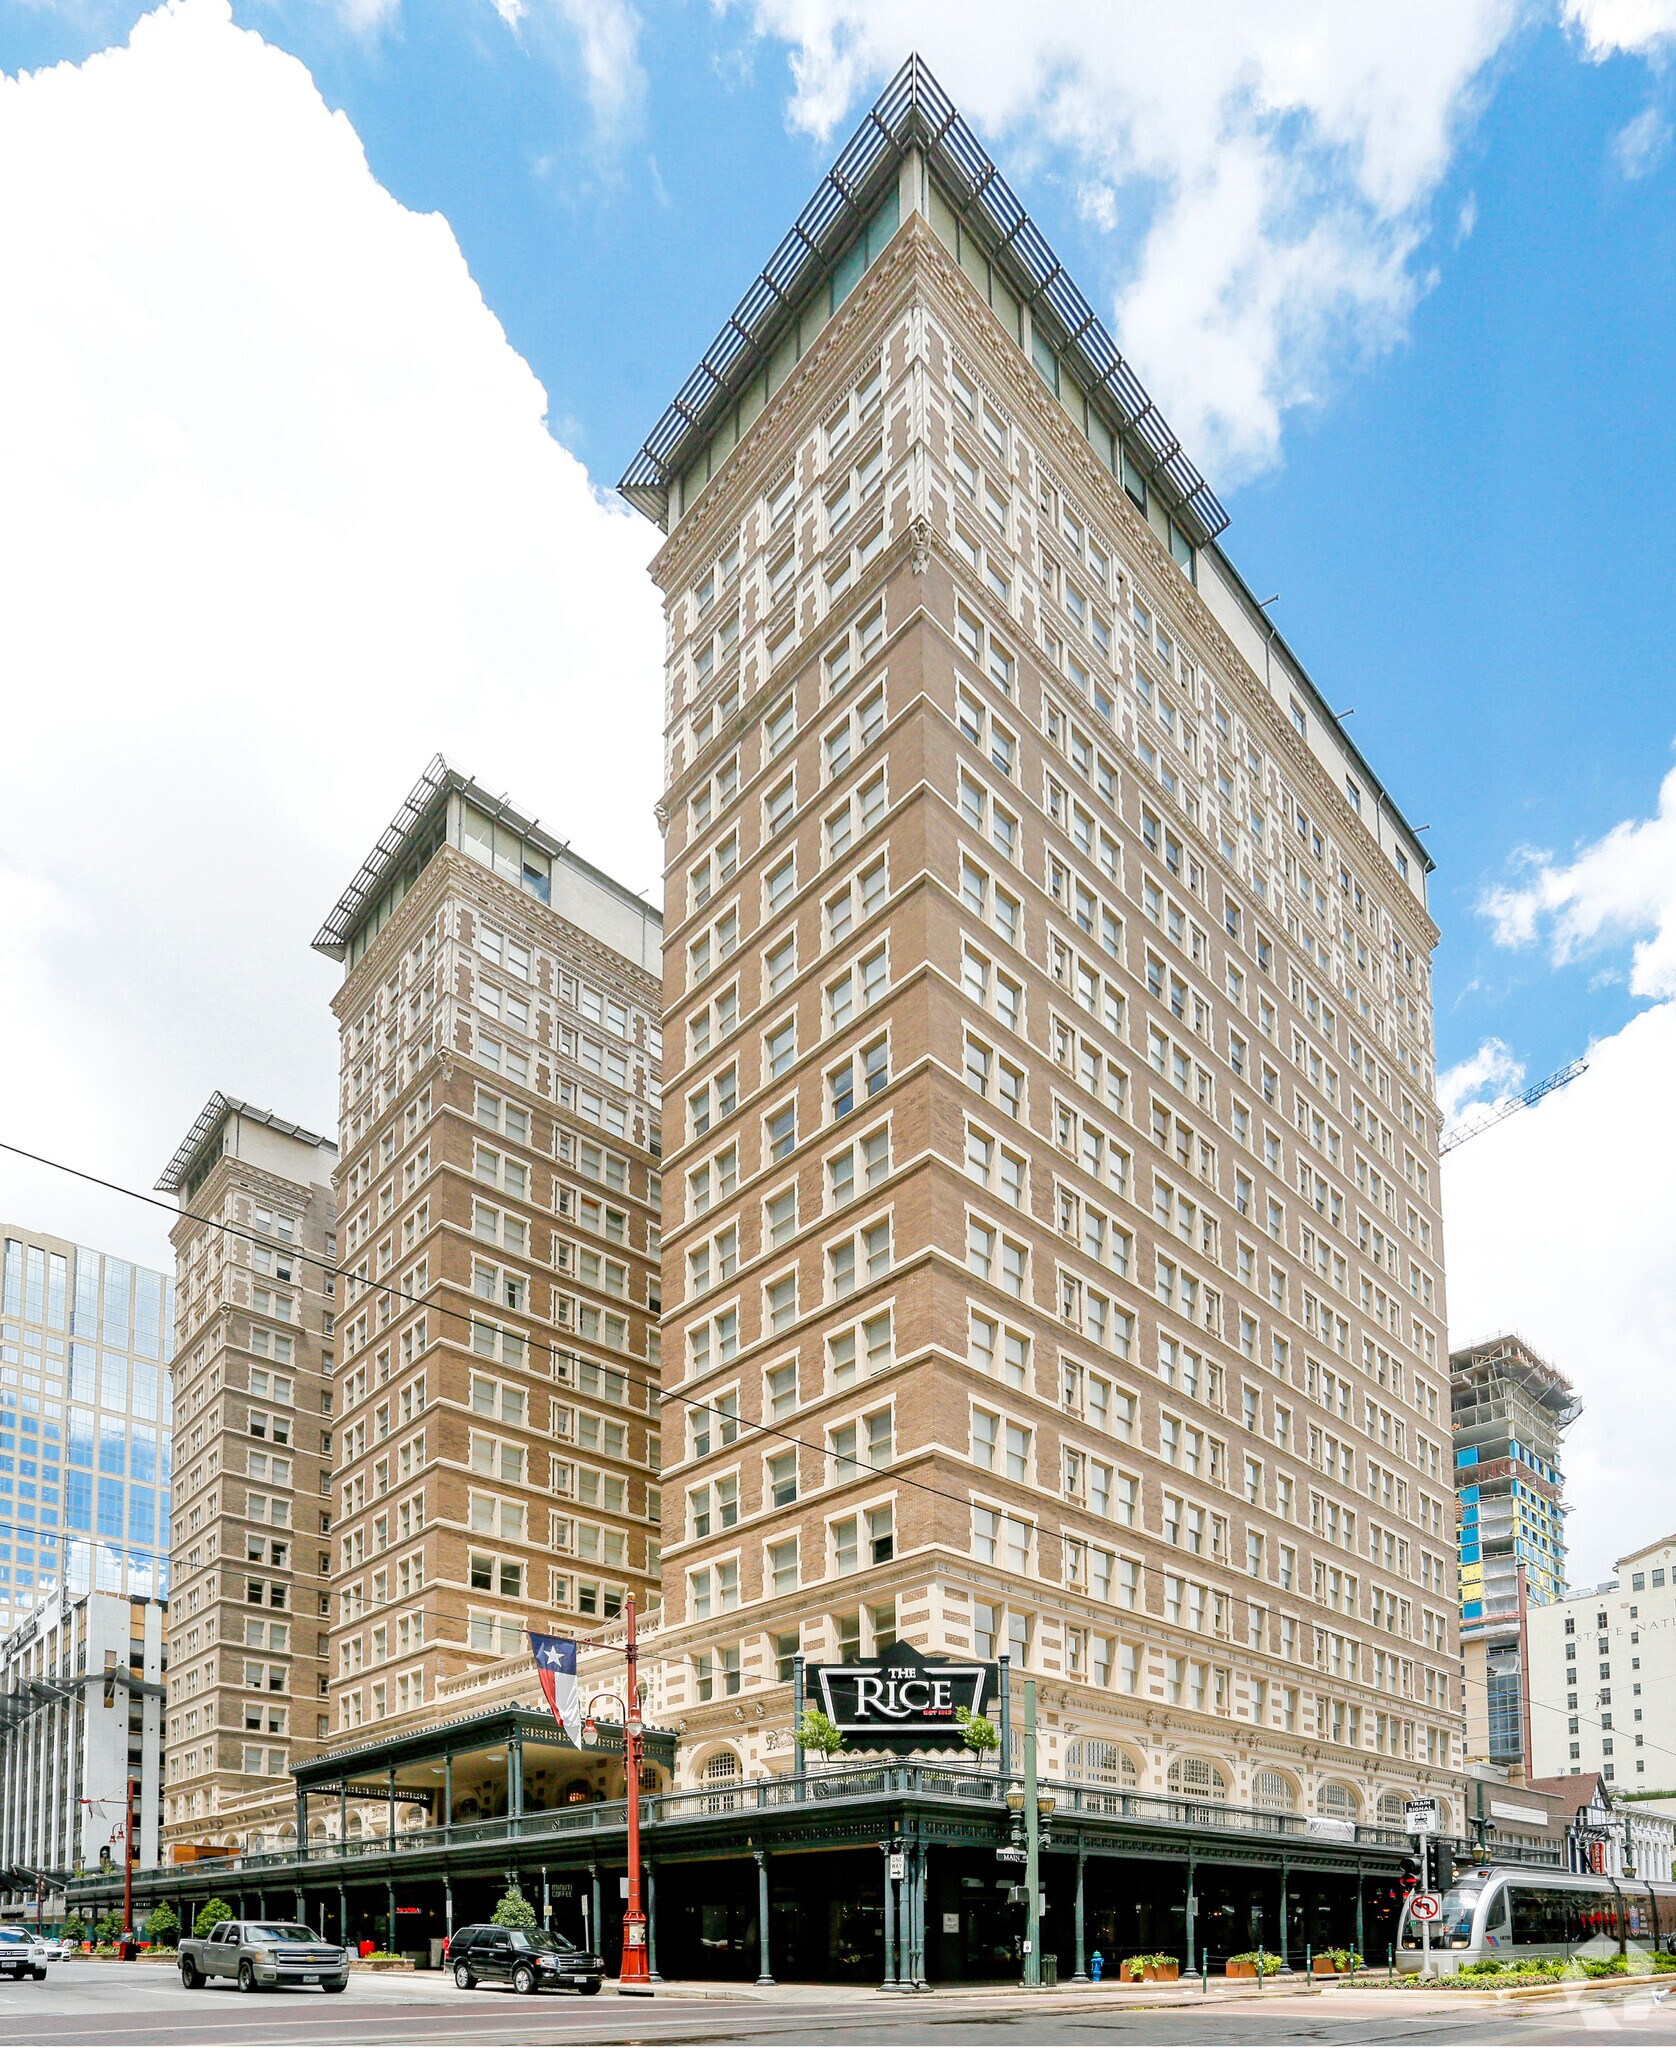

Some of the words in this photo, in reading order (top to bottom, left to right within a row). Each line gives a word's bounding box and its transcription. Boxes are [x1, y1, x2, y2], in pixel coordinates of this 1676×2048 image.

[1575, 1627, 1623, 1643] STATE
[888, 1668, 916, 1679] THE
[853, 1677, 952, 1717] RICE
